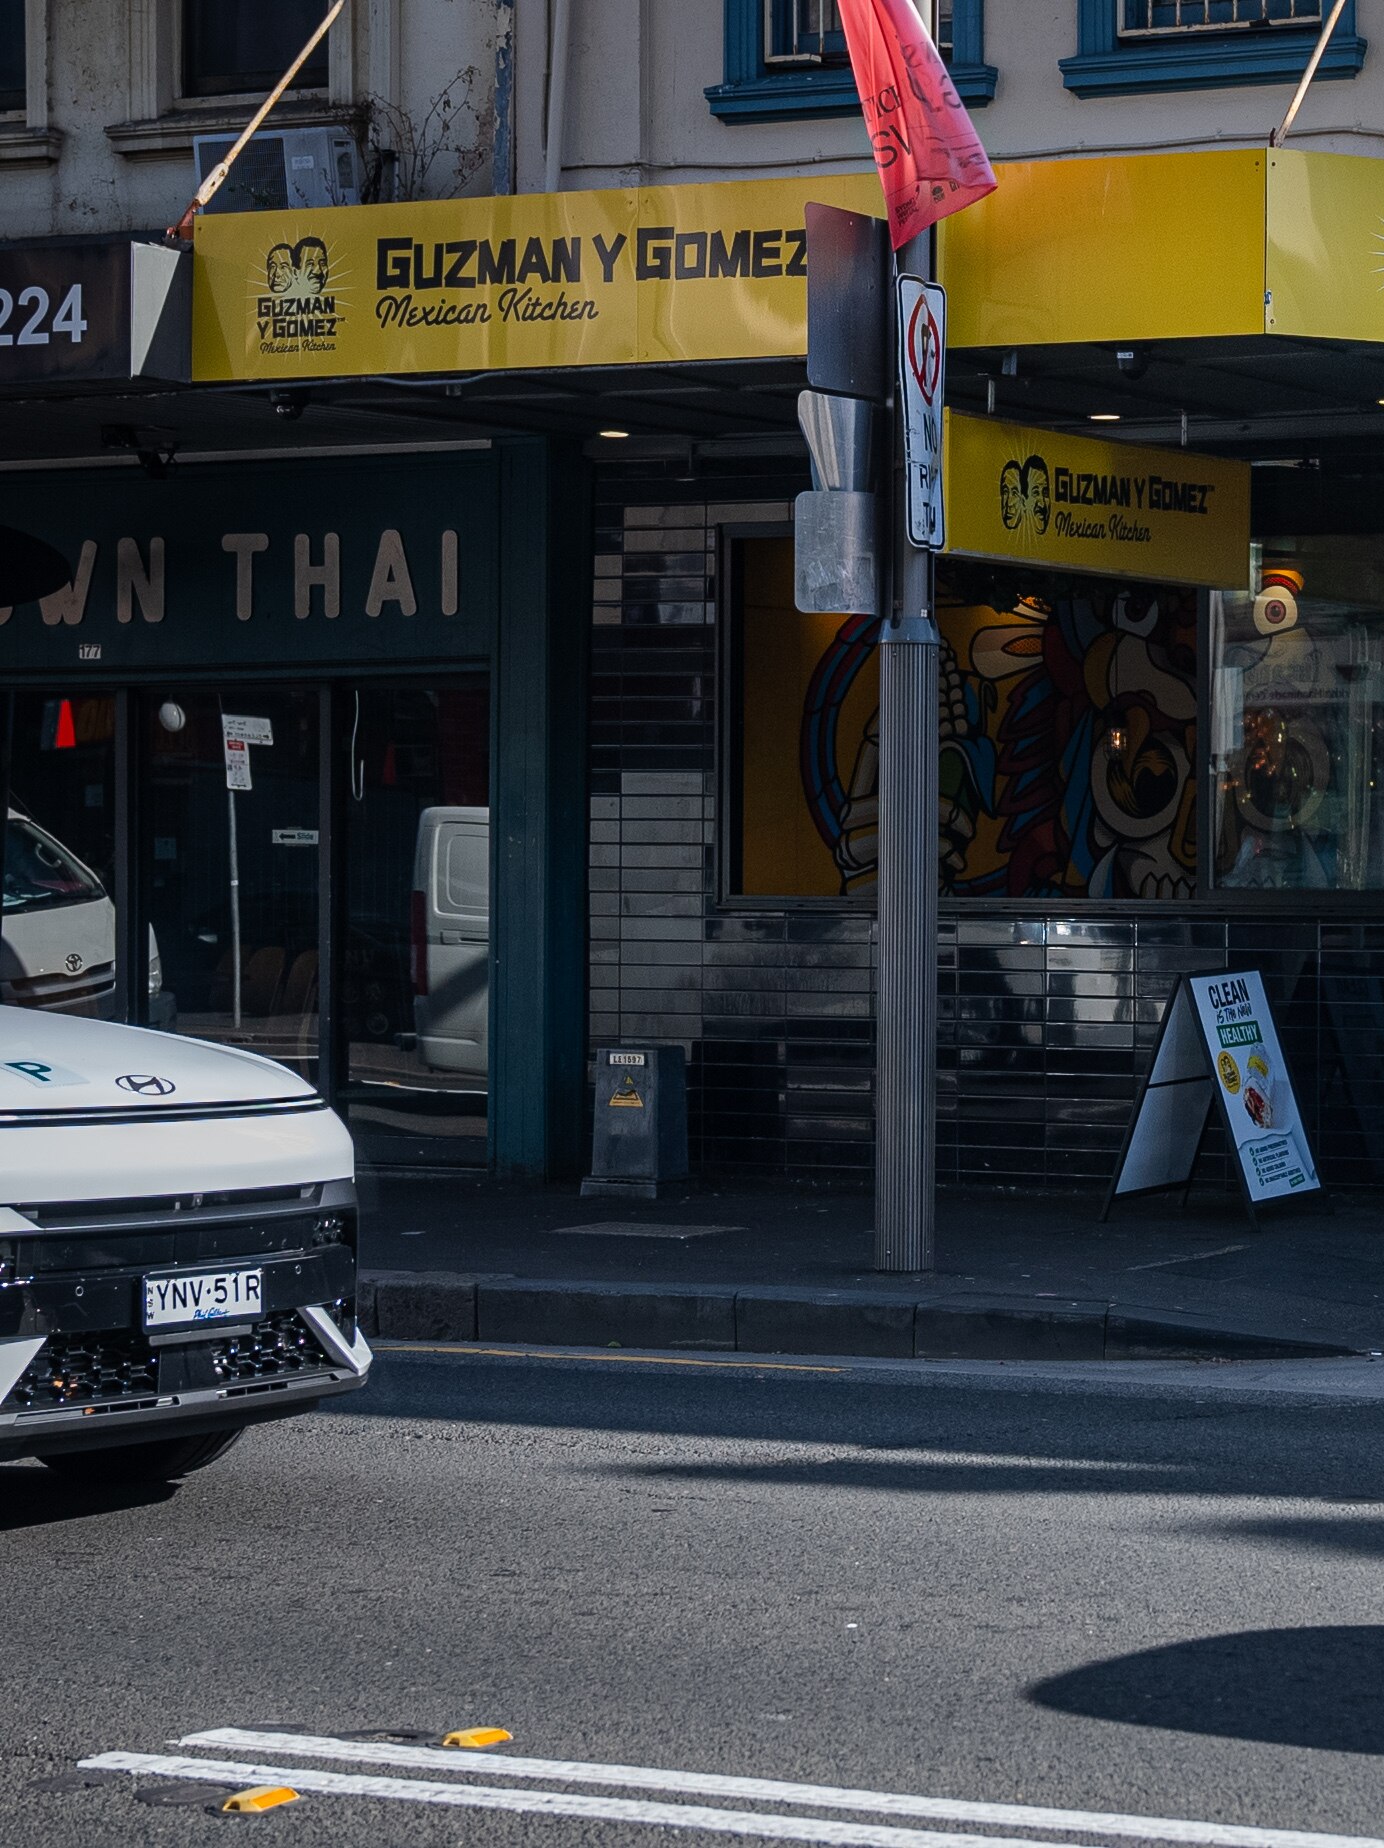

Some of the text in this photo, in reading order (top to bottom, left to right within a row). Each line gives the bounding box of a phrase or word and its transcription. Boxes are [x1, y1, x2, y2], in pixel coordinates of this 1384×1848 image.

[377, 237, 581, 290] GUZMAN
[592, 233, 627, 283] Y
[257, 296, 335, 318] GUZMAN
[375, 287, 599, 328] Mexican Kitchen
[257, 320, 270, 340] Y
[260, 338, 336, 354] Mexican Kitchen
[1055, 467, 1131, 507] GUZMAN
[1133, 477, 1146, 509] Y
[1055, 511, 1152, 542] Mexican Kitchen
[221, 529, 458, 621] THAI
[79, 644, 101, 659] 177
[1208, 978, 1250, 1009] CLEAN
[1219, 1024, 1258, 1045] HEALTHY
[4, 1061, 52, 1082] P
